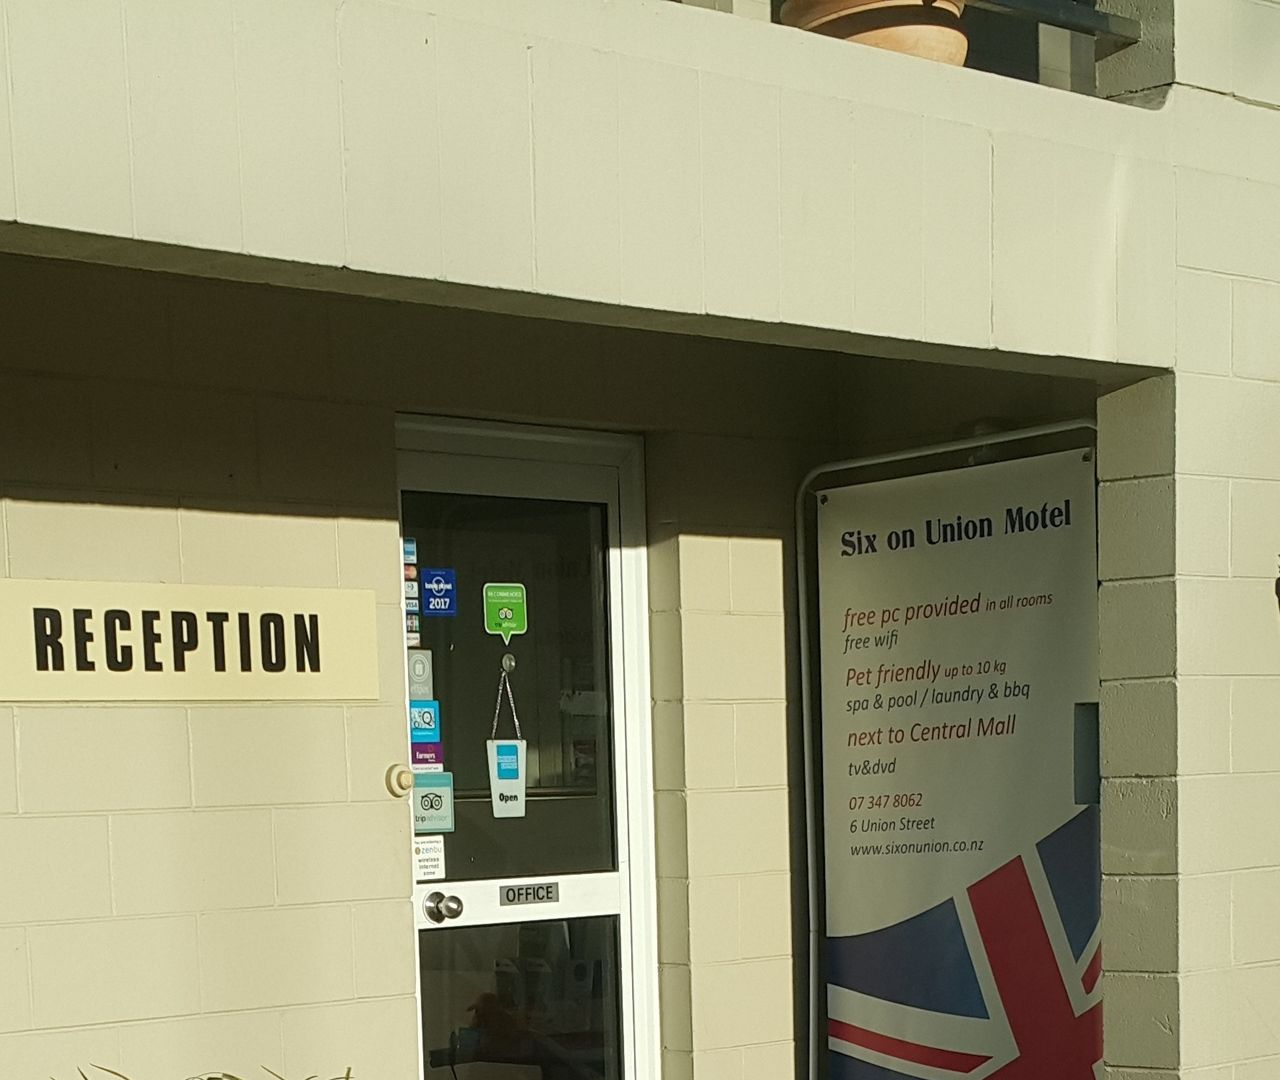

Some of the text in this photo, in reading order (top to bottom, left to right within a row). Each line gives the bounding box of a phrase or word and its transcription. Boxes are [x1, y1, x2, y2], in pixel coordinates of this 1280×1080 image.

[841, 499, 1071, 557] Six on Union Motel
[429, 598, 450, 609] 2017
[842, 592, 1053, 632] free pc provided in all rooms
[32, 607, 320, 673] RECEPTION
[843, 629, 898, 654] free wifi
[846, 659, 1006, 689] Pet friendly up to 10 kg
[846, 681, 1030, 715] spa & pool / laundry & bbq
[847, 714, 1016, 746] next to Central Mall
[848, 757, 897, 776] tv&dvd
[499, 793, 518, 803] Open
[849, 793, 923, 810] 07 347 8062
[849, 817, 935, 833] 6 Union Street
[850, 840, 984, 856] www.sixonunion.co.nz
[506, 885, 553, 903] OFFICE
